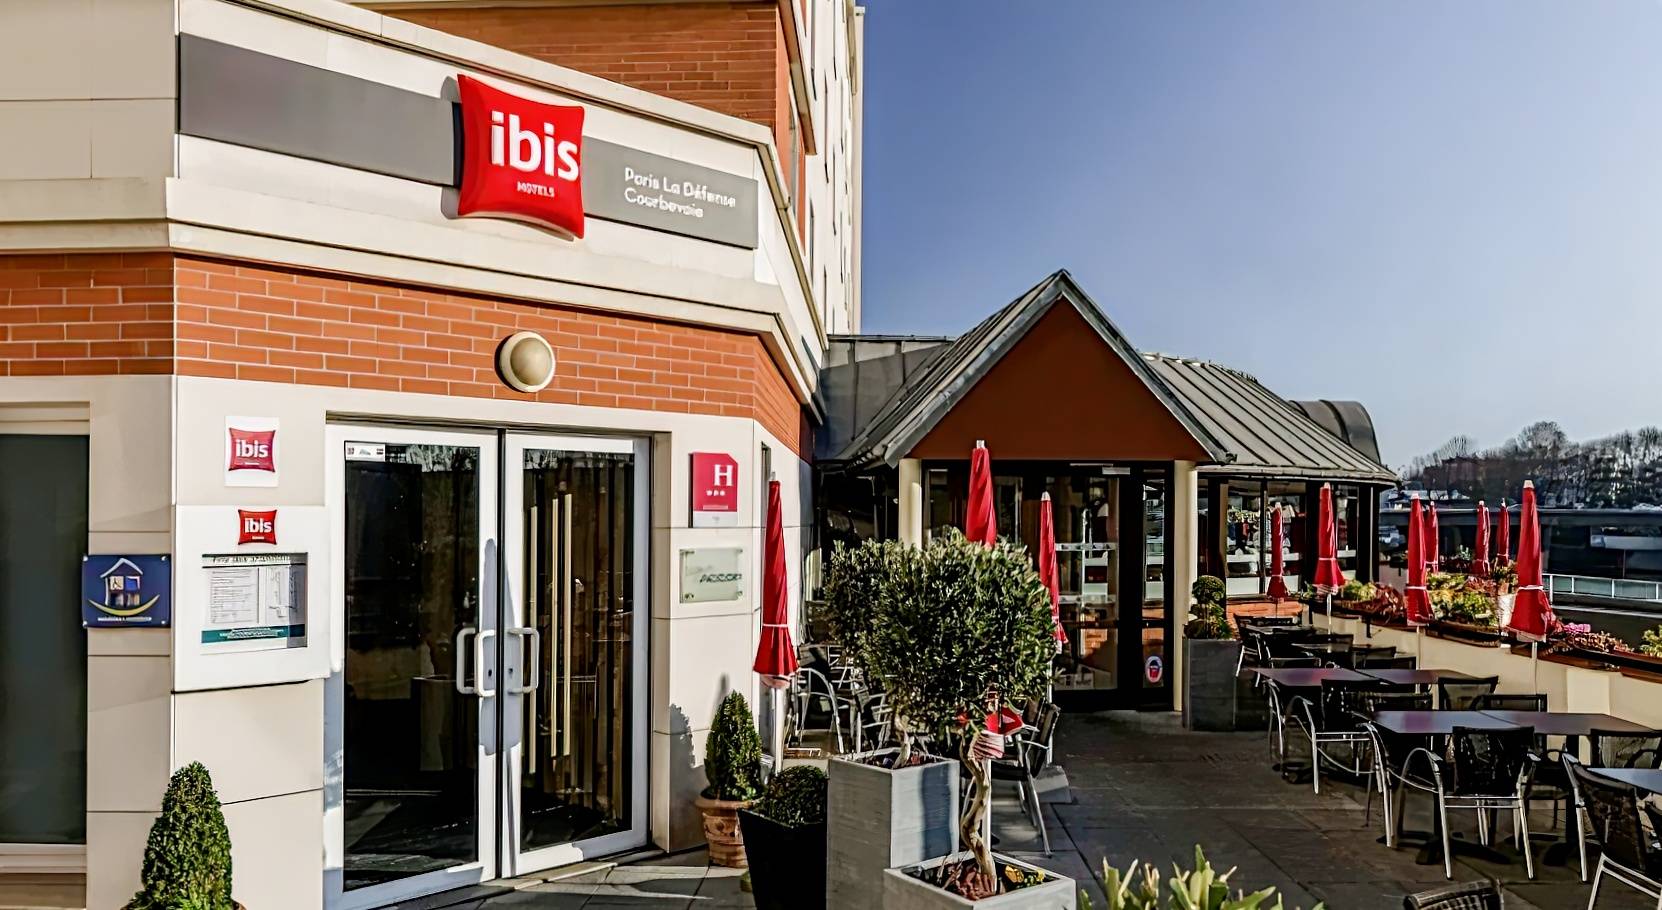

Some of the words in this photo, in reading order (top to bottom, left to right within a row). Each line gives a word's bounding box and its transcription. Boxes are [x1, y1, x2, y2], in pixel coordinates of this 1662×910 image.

[491, 110, 579, 181] ibis
[625, 167, 659, 189] Paris
[663, 177, 680, 194] La
[235, 439, 268, 458] ibis
[713, 463, 734, 487] H
[244, 518, 272, 533] ibis
